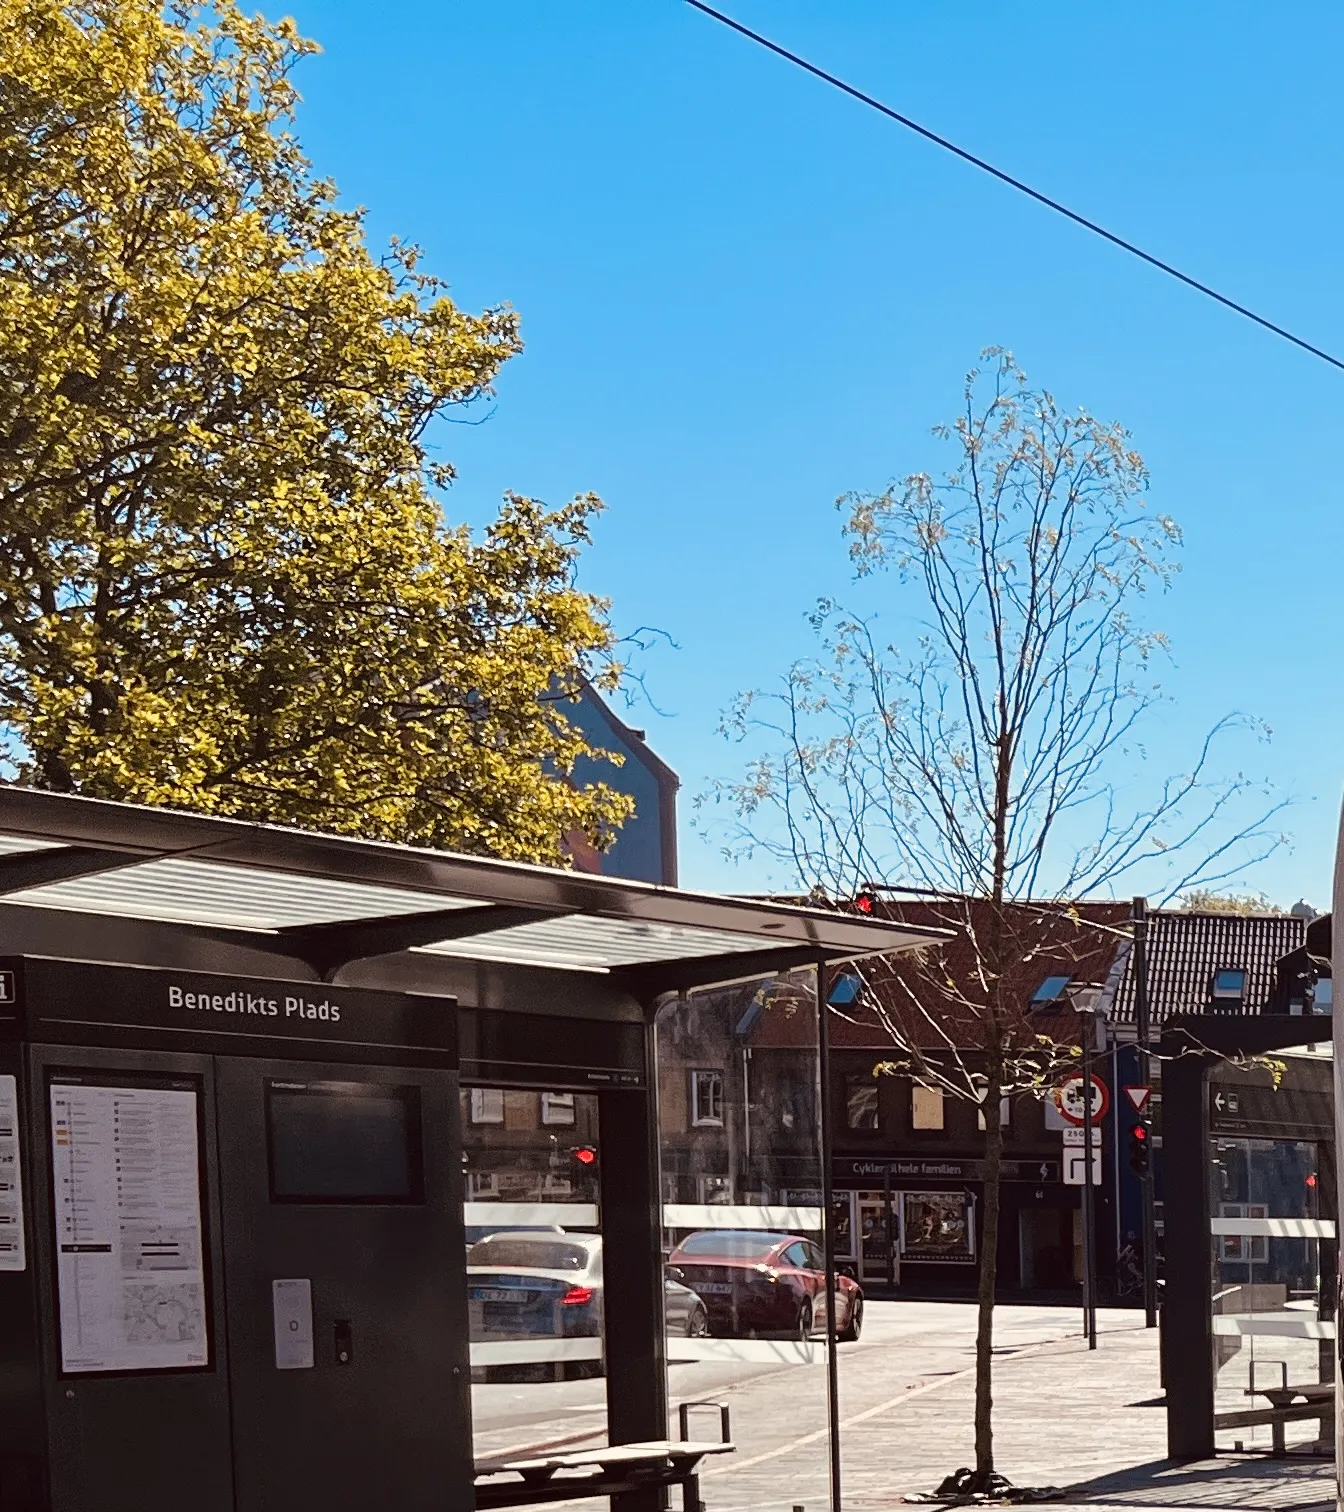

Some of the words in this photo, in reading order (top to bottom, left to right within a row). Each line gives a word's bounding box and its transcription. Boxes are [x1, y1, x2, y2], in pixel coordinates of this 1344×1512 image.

[168, 986, 279, 1017] Benedikts
[285, 996, 341, 1022] Plads
[921, 1162, 961, 1175] familien
